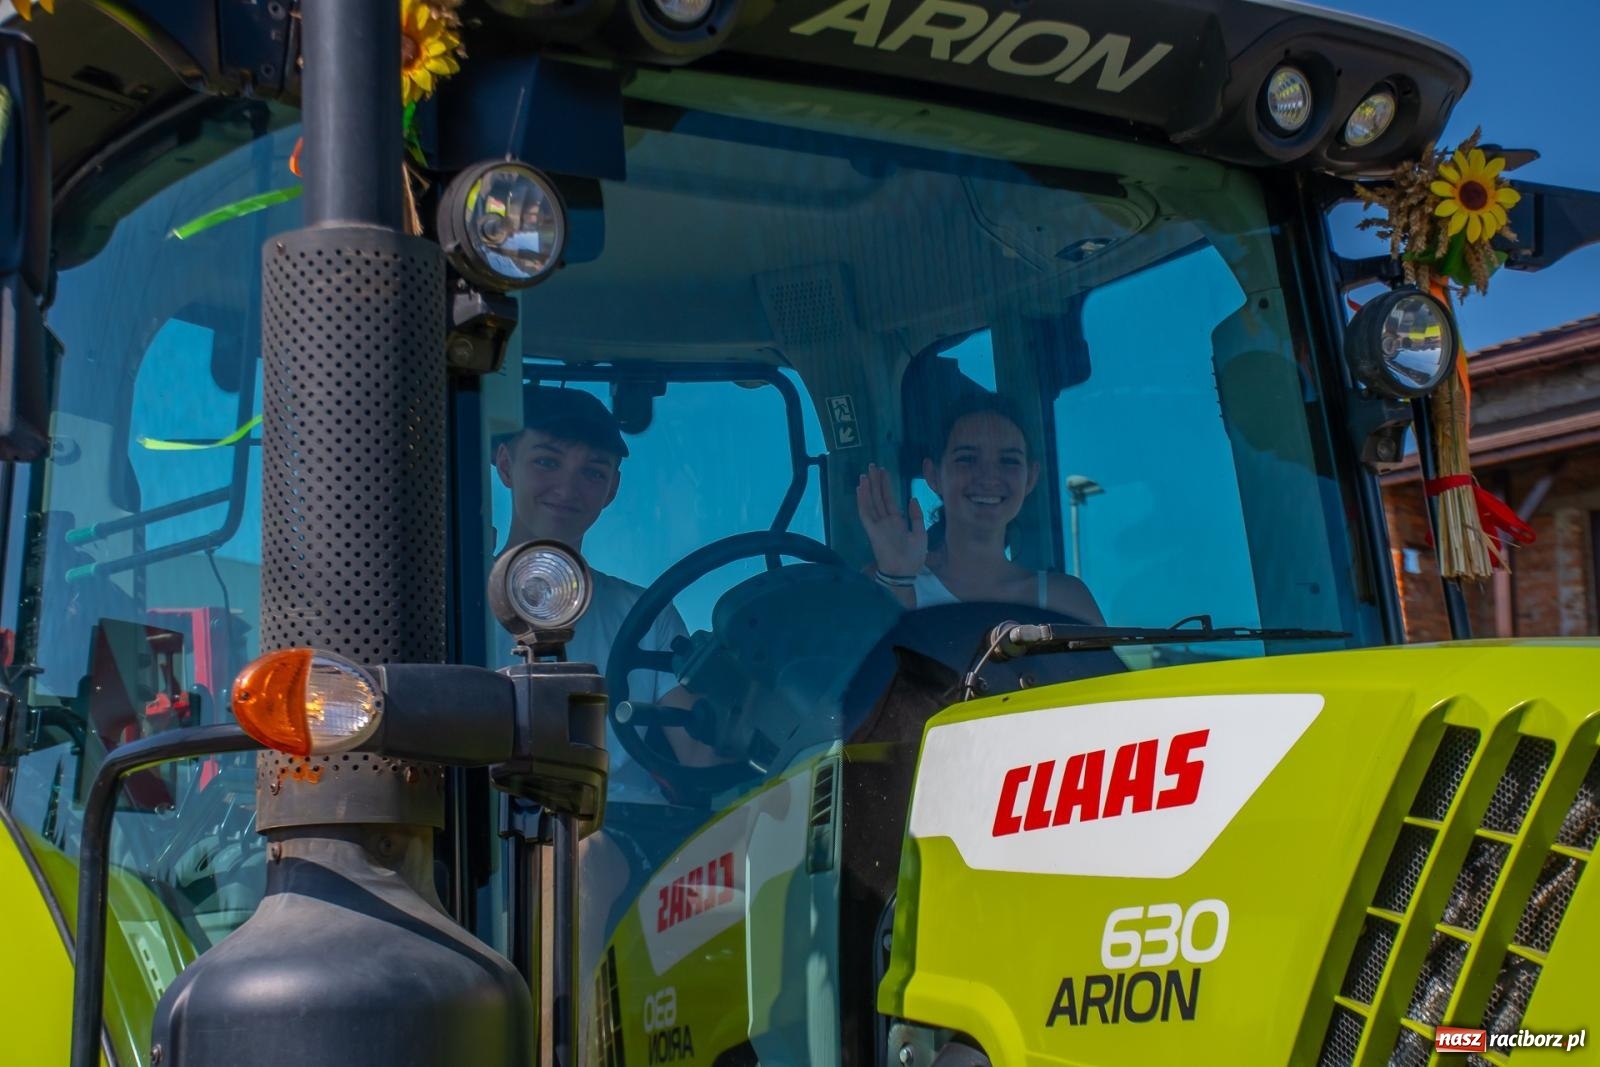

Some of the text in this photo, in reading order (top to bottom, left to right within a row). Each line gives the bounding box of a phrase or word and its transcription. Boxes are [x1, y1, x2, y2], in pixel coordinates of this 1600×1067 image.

[789, 0, 1173, 93] ARION
[992, 728, 1210, 838] CLAAS
[1101, 898, 1230, 970] 630
[1045, 968, 1202, 1028] ARION
